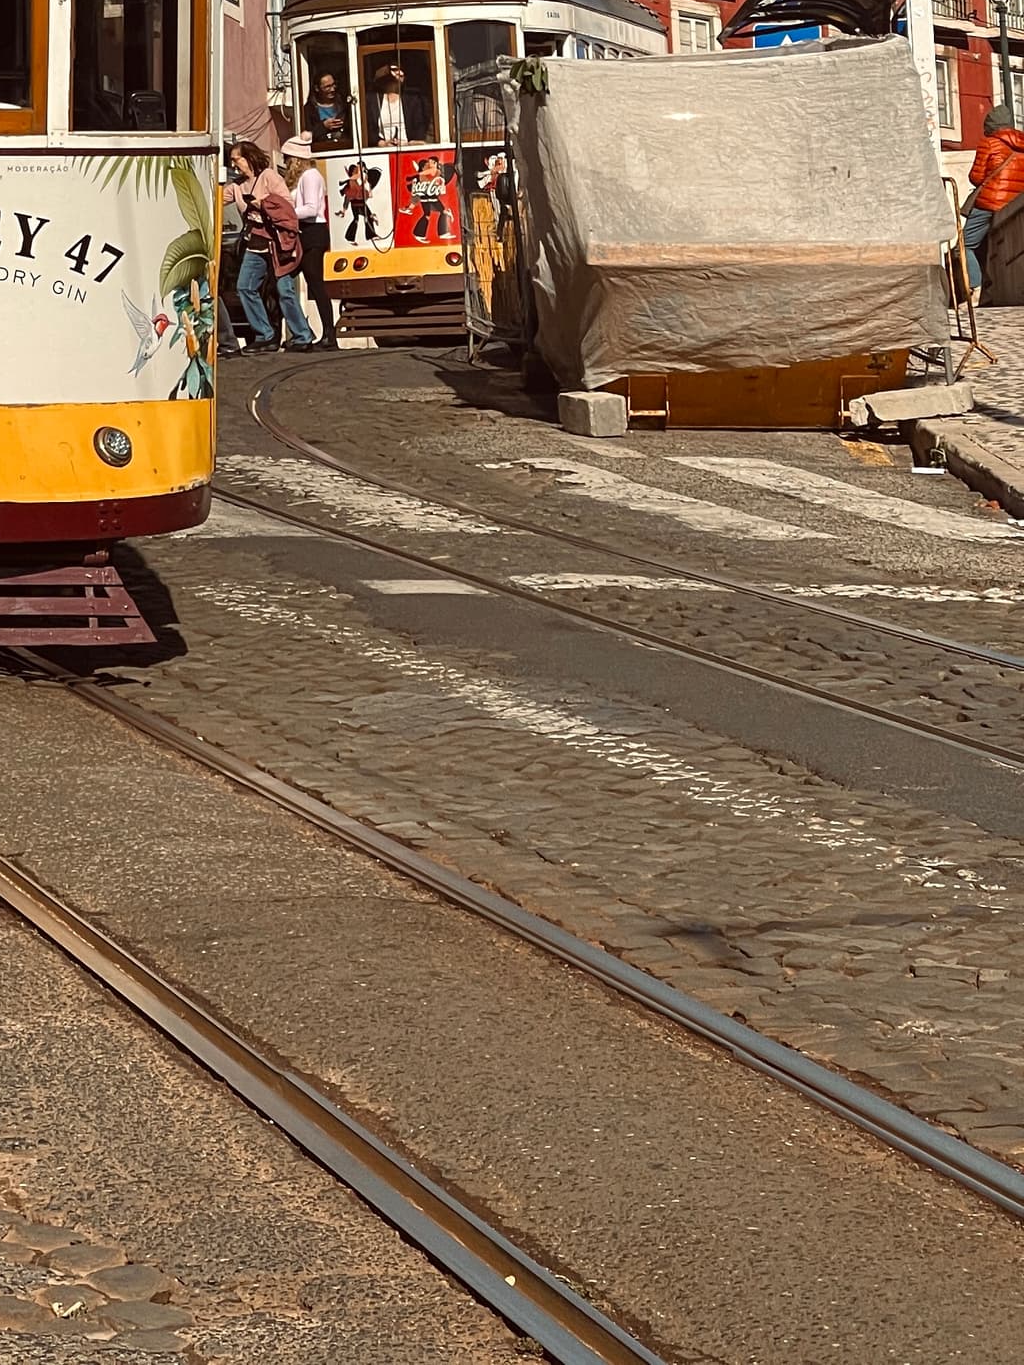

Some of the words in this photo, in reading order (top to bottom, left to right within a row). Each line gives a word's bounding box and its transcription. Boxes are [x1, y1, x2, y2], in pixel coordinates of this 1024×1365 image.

[7, 164, 69, 173] MODERAÇÃO
[64, 234, 125, 283] 47
[52, 280, 87, 303] GIN
